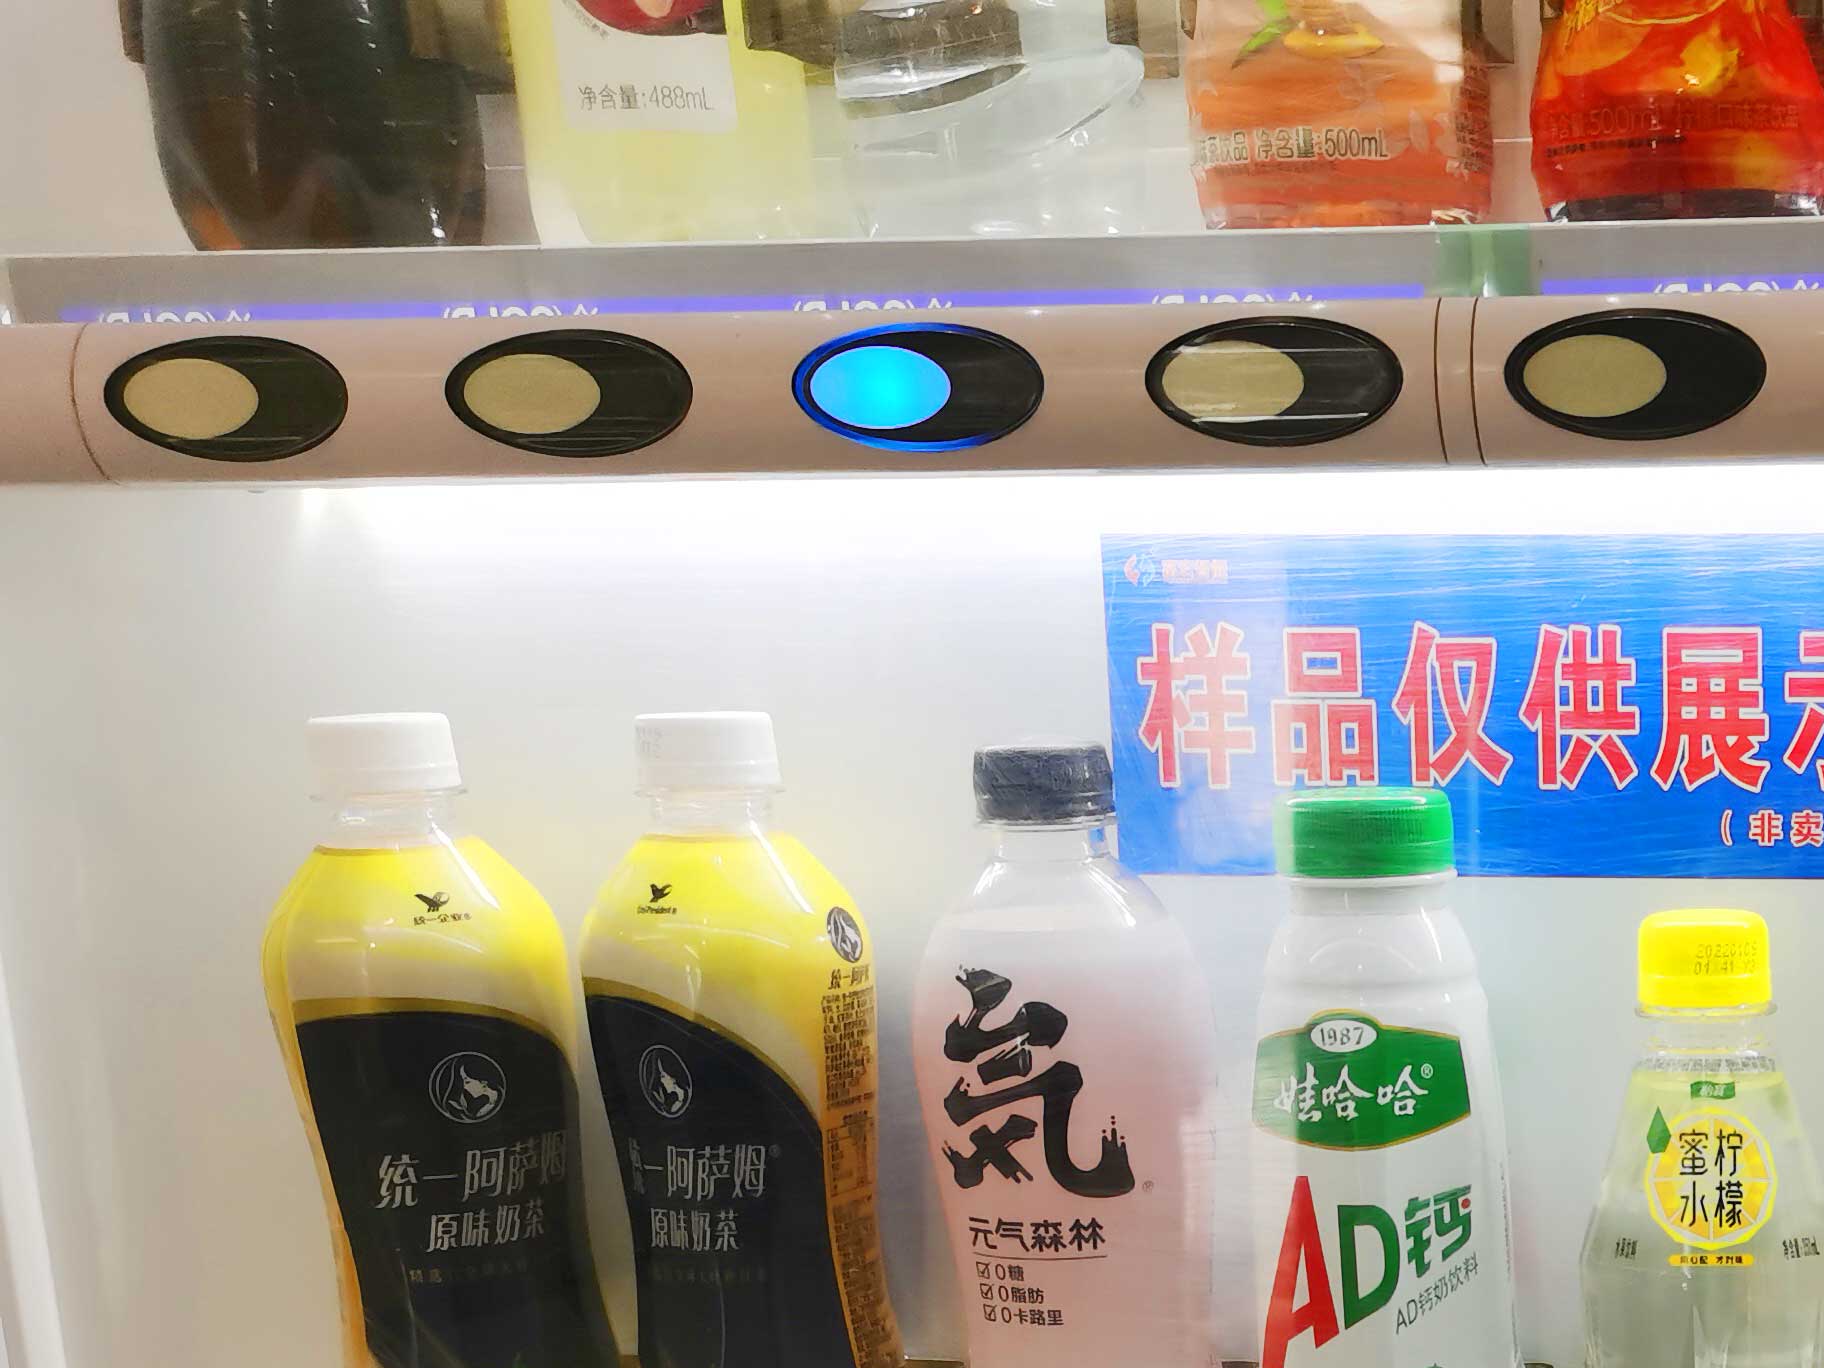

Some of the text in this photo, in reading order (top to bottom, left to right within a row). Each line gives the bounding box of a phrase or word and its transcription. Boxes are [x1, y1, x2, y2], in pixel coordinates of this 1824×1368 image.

[1319, 1026, 1366, 1047] 1987
[1272, 1061, 1429, 1122] 娃哈哈
[374, 1129, 569, 1209] 统一阿萨姆
[425, 1196, 546, 1254] 原味奶茶
[650, 1206, 740, 1252] 原味奶茶
[968, 1215, 1106, 1253] 元气森林
[1395, 1251, 1480, 1336] AD钙奶饮料
